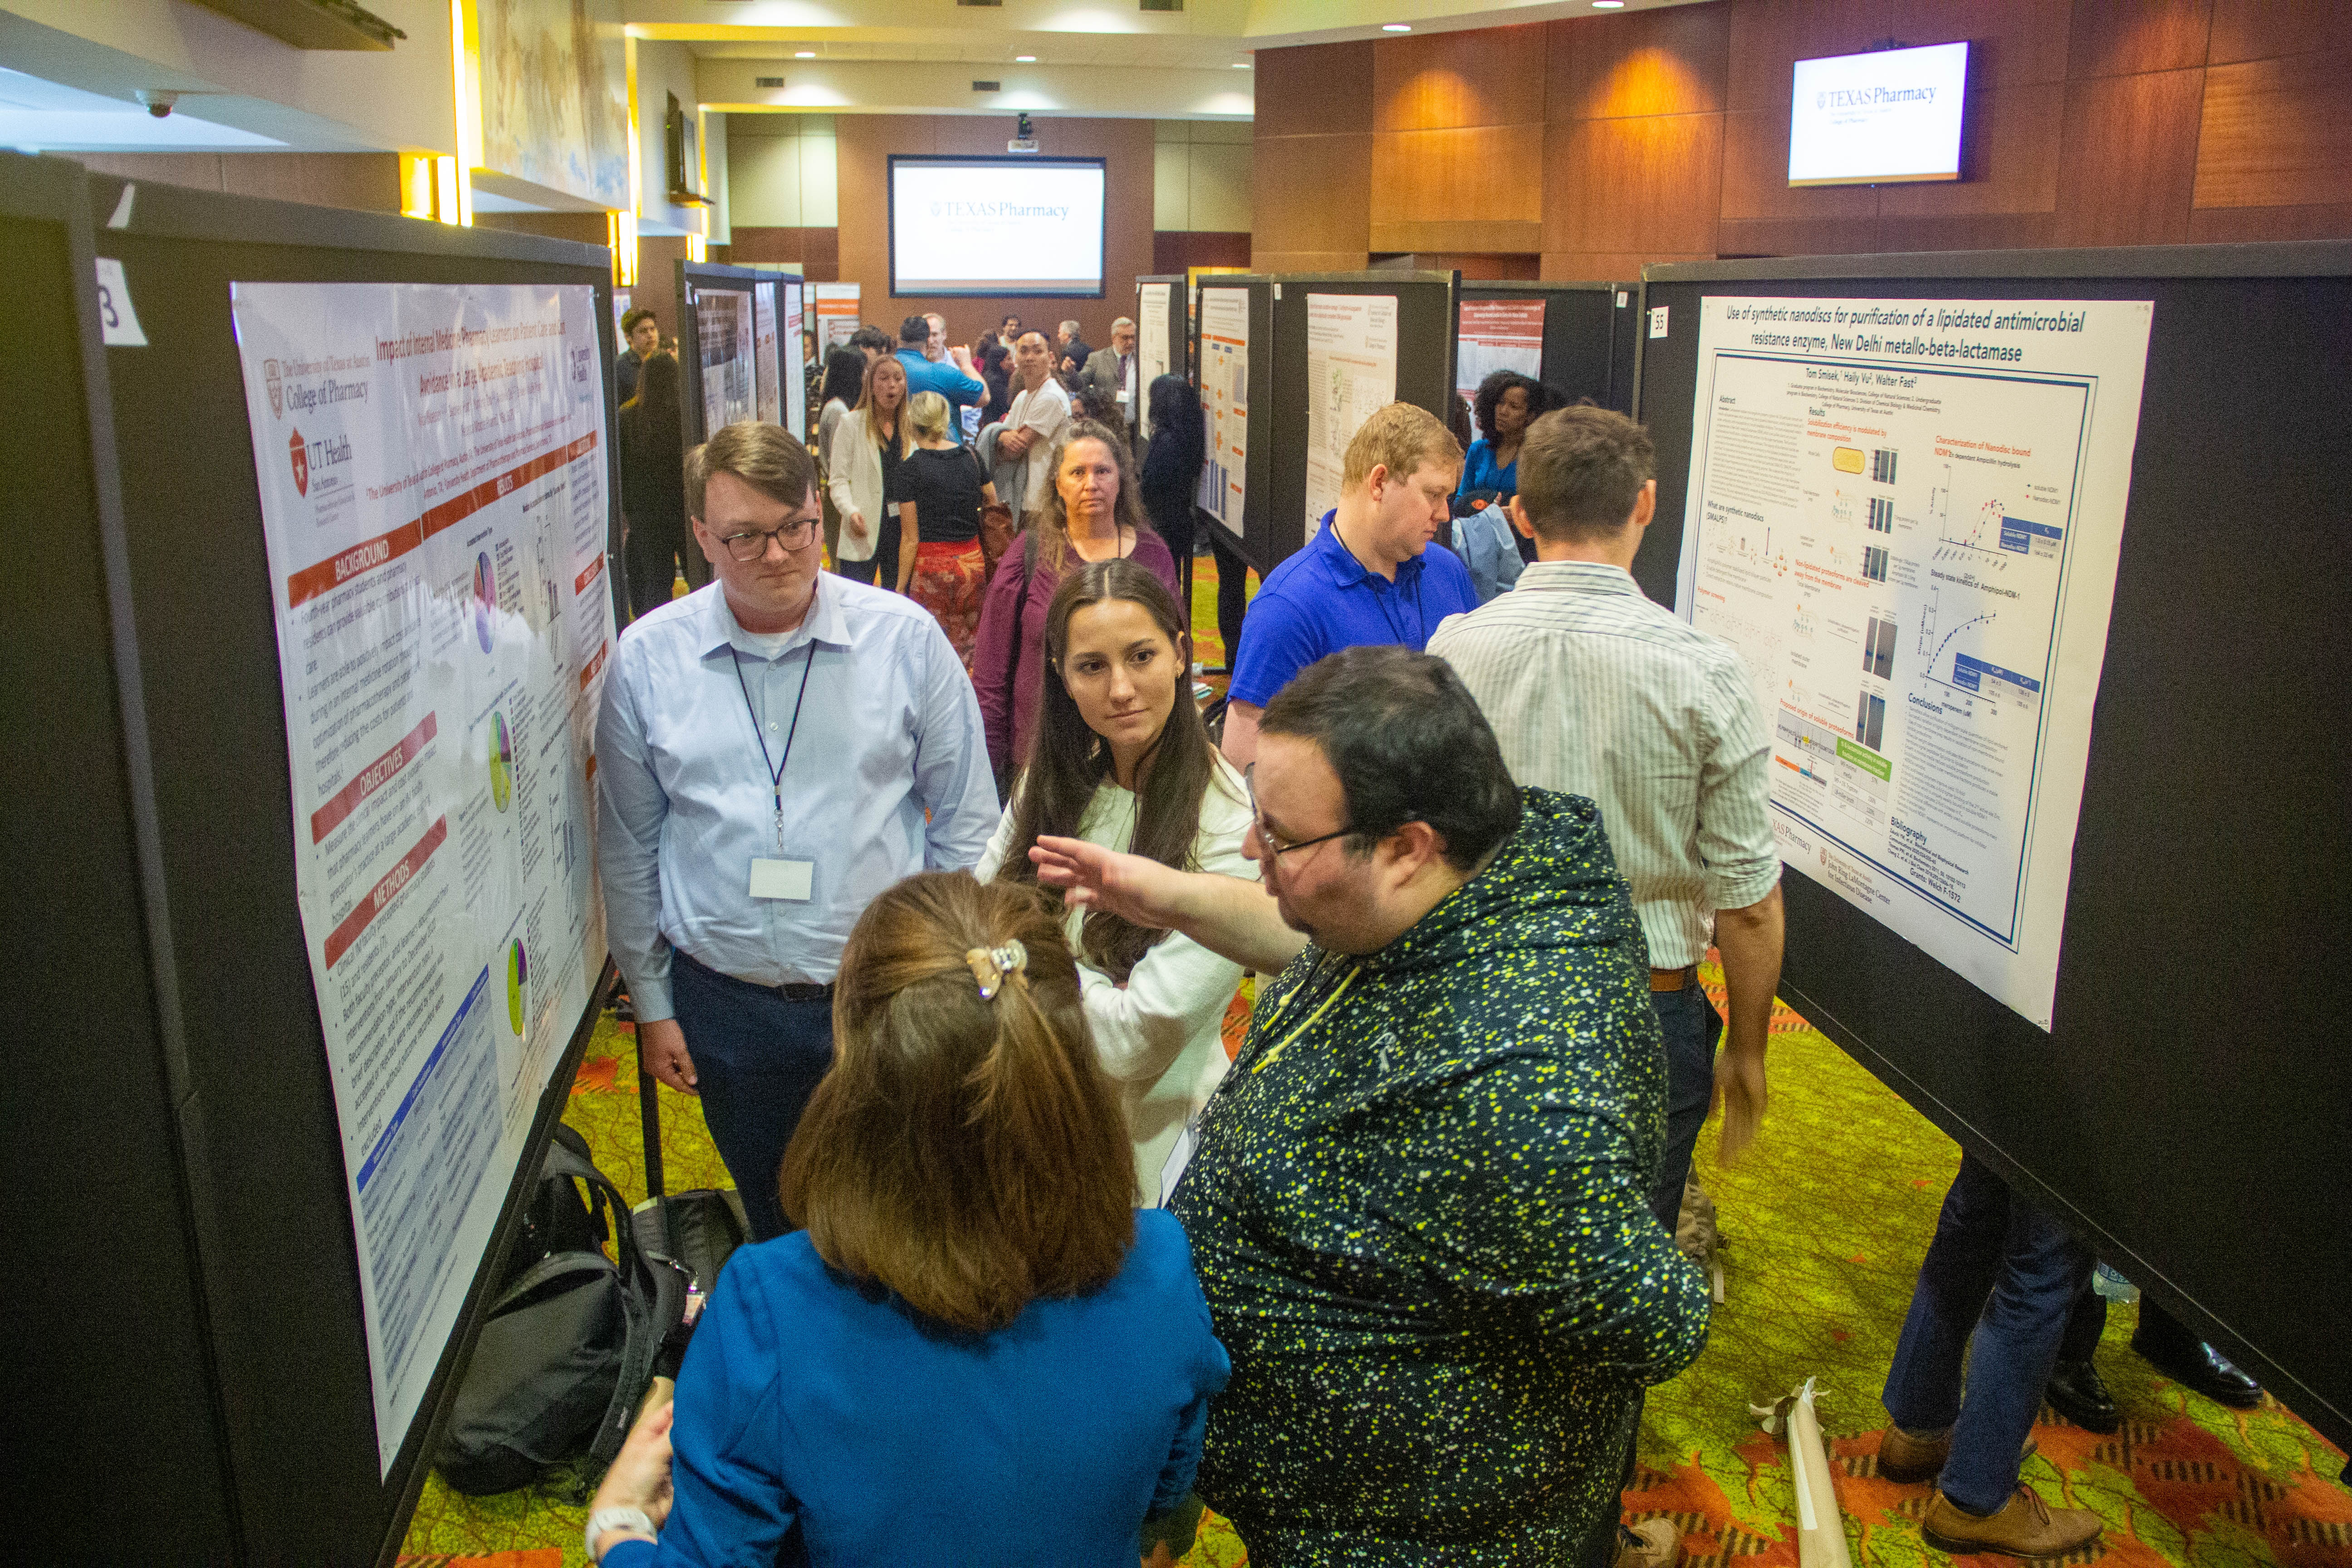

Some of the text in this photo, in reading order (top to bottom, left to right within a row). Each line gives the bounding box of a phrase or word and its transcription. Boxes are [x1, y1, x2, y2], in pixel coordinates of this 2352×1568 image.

[1828, 87, 1936, 108] TEXAS Pharmacy
[944, 201, 1069, 220] TEXAS Pharmacy
[1656, 314, 1663, 329] 55
[1727, 304, 2086, 333] Use of synthetic nanodiscs for purification of a lipidated antimicrobial
[375, 335, 404, 366] Impact
[1751, 330, 2022, 362] resistance enzyme, New Delhi metallo-beta-lactamase
[1805, 368, 1818, 379] Tom
[1875, 373, 1897, 387] Walter
[286, 379, 368, 414] College of Pharmacy
[1719, 395, 1736, 404] Abstract
[1809, 407, 1825, 416] Results
[1807, 429, 1851, 444] membrane composition
[1808, 418, 1832, 428] Solubilization
[1833, 421, 1852, 433] efficiency
[1857, 425, 1880, 436] modulated
[1881, 429, 1886, 438] by
[307, 434, 353, 470] UT Health
[1935, 435, 2031, 457] Characterization of Nanodisc bound
[1707, 500, 1718, 509] What
[1725, 506, 1743, 518] synthetic
[1744, 510, 1764, 522] nanodiscs
[335, 540, 389, 581] BACKGROUND
[1795, 559, 1820, 573] Non-lipidated
[1821, 567, 1845, 582] proteoforms
[1853, 578, 1869, 588] cleaved
[1697, 586, 1725, 603] Polymer screening
[1794, 570, 1803, 580] away
[1804, 572, 1813, 581] from
[1821, 578, 1842, 591] membrane
[1930, 568, 2020, 601] Steady state kinetics of Amphipol-NDM-1
[1908, 691, 1943, 715] Conclusions
[1780, 698, 1854, 740] Proposed origin of soluble proteoforms
[360, 747, 403, 795] OBJECTIVES
[1773, 818, 1811, 856] XAS Pharmacy
[1890, 815, 1927, 846] Bibliography
[374, 860, 409, 911] METHODS
[1828, 859, 1890, 906] John LaMontagne Center
[1835, 874, 1855, 894] Infectious
[1856, 886, 1872, 904] Disease
[1910, 867, 1960, 903] Grants: Welch F-1572
